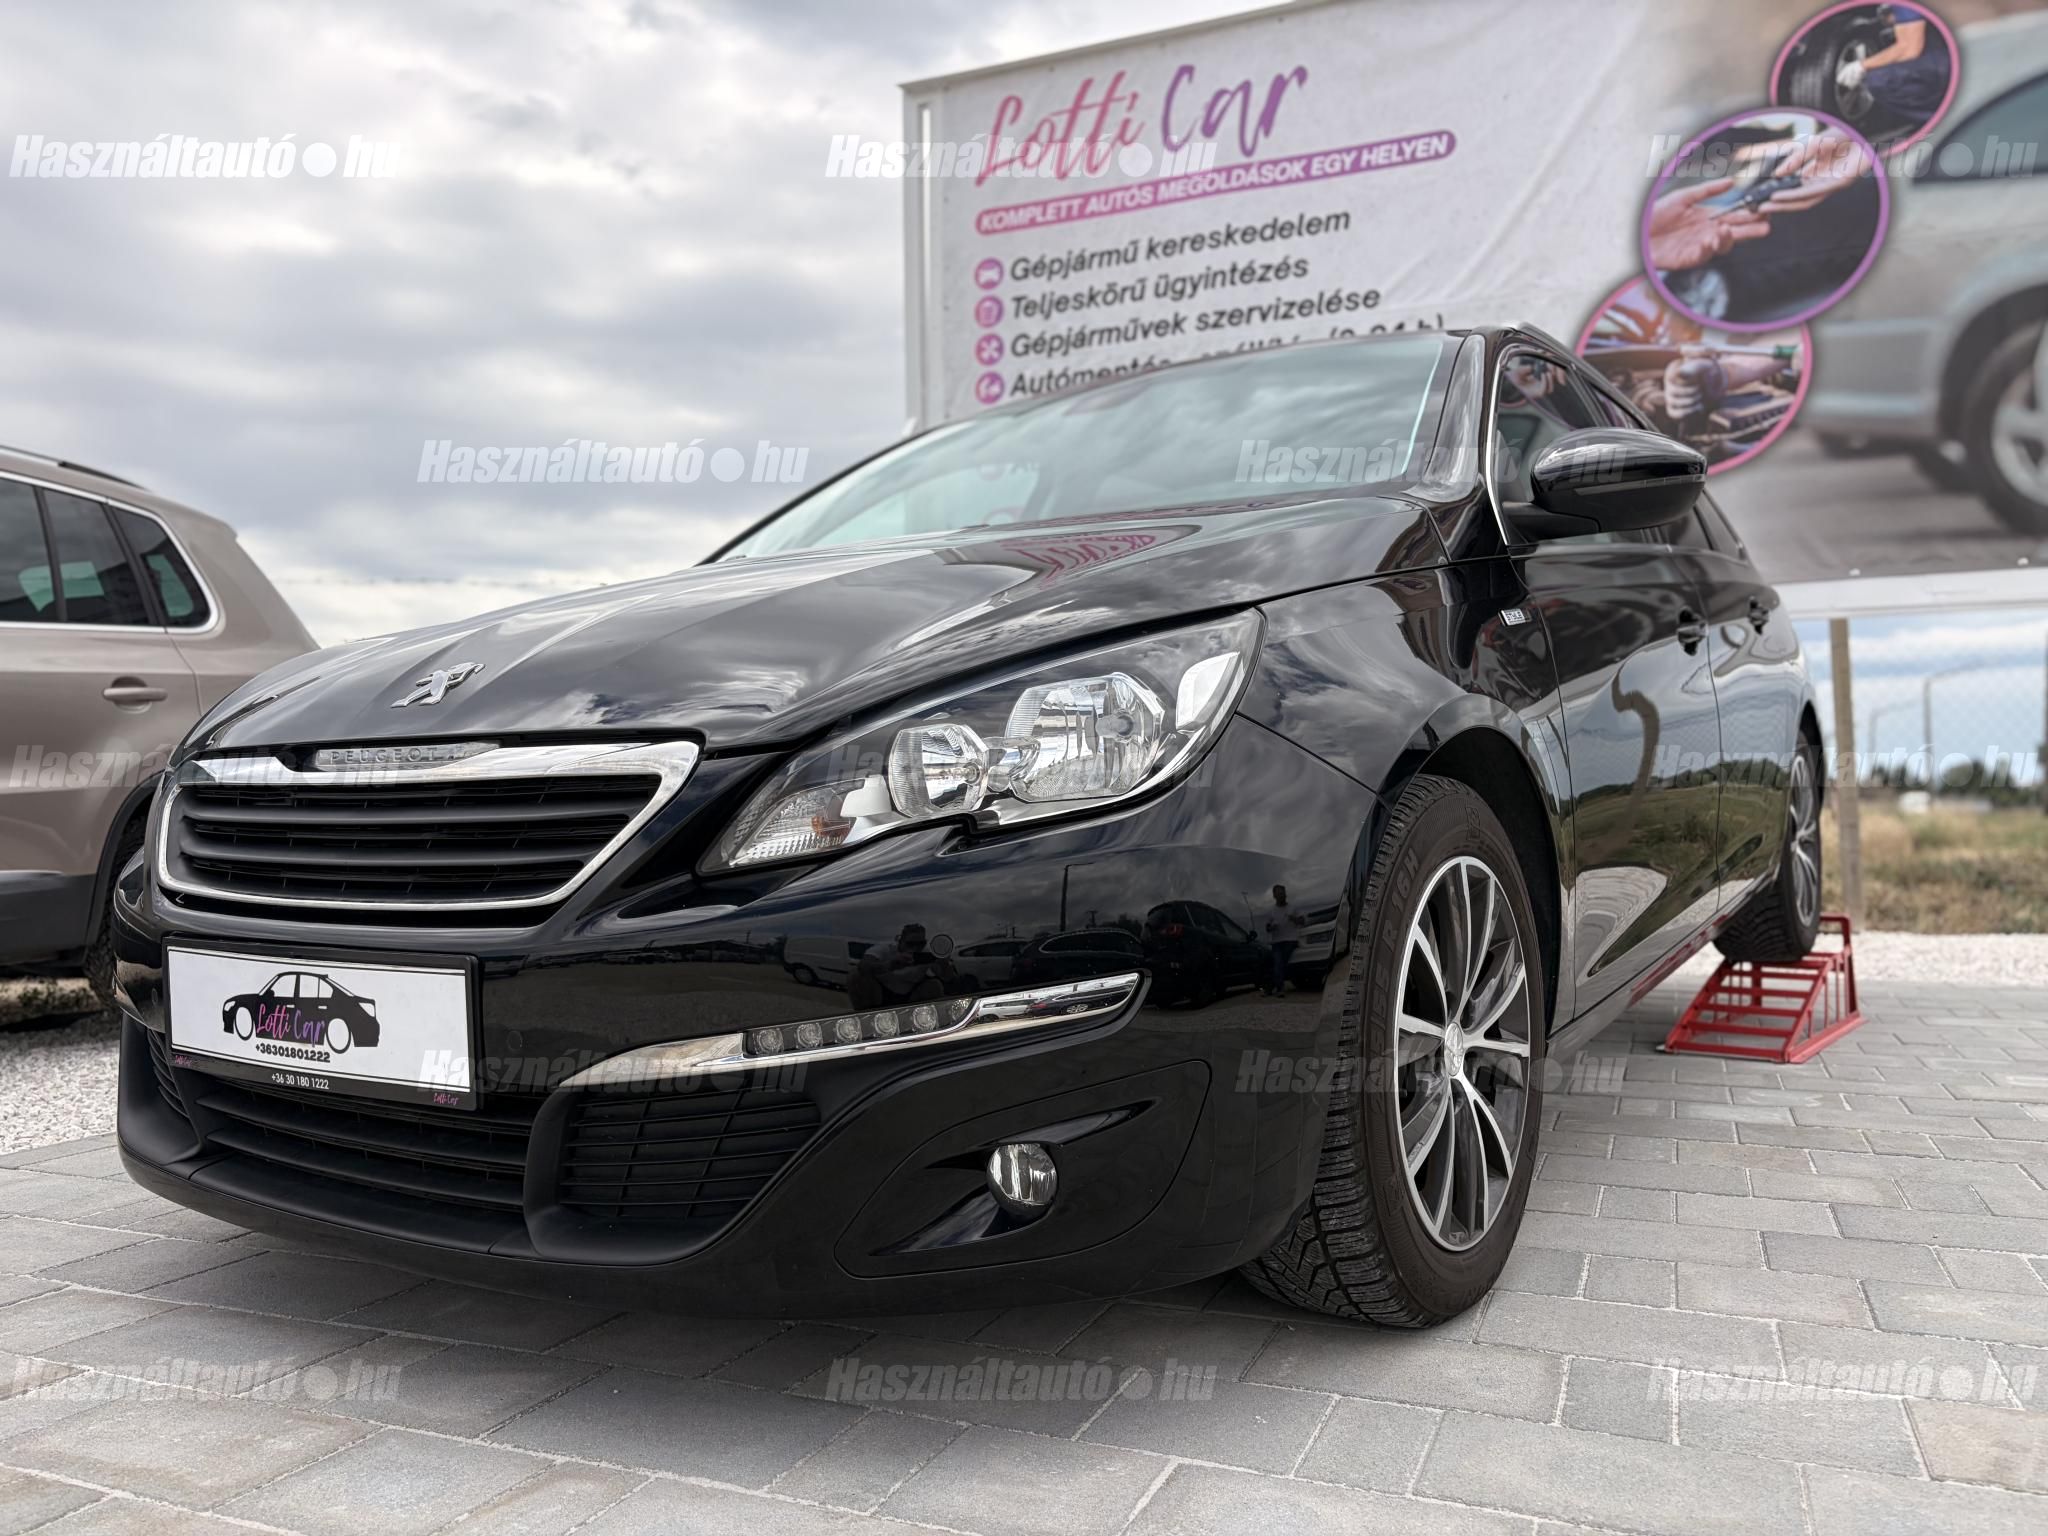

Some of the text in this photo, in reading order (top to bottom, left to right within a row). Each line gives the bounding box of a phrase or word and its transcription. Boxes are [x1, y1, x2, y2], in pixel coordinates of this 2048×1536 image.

[974, 64, 1308, 187] Lotti Car
[980, 134, 1449, 231] KOMPLETT AUTÓS MEGOLDÁSOK EGY HELYEN
[1010, 211, 1351, 281] Gépjármű kereskedelem
[1154, 254, 1310, 301] ügyintézés
[1010, 312, 1187, 358] Gépjárművek
[1195, 288, 1381, 332] szervizelése
[330, 747, 438, 764] PEUGEOT
[256, 1003, 326, 1048] Lotti Car
[255, 1043, 331, 1063] +36301801222
[271, 1072, 329, 1090] +36 30 180 1222
